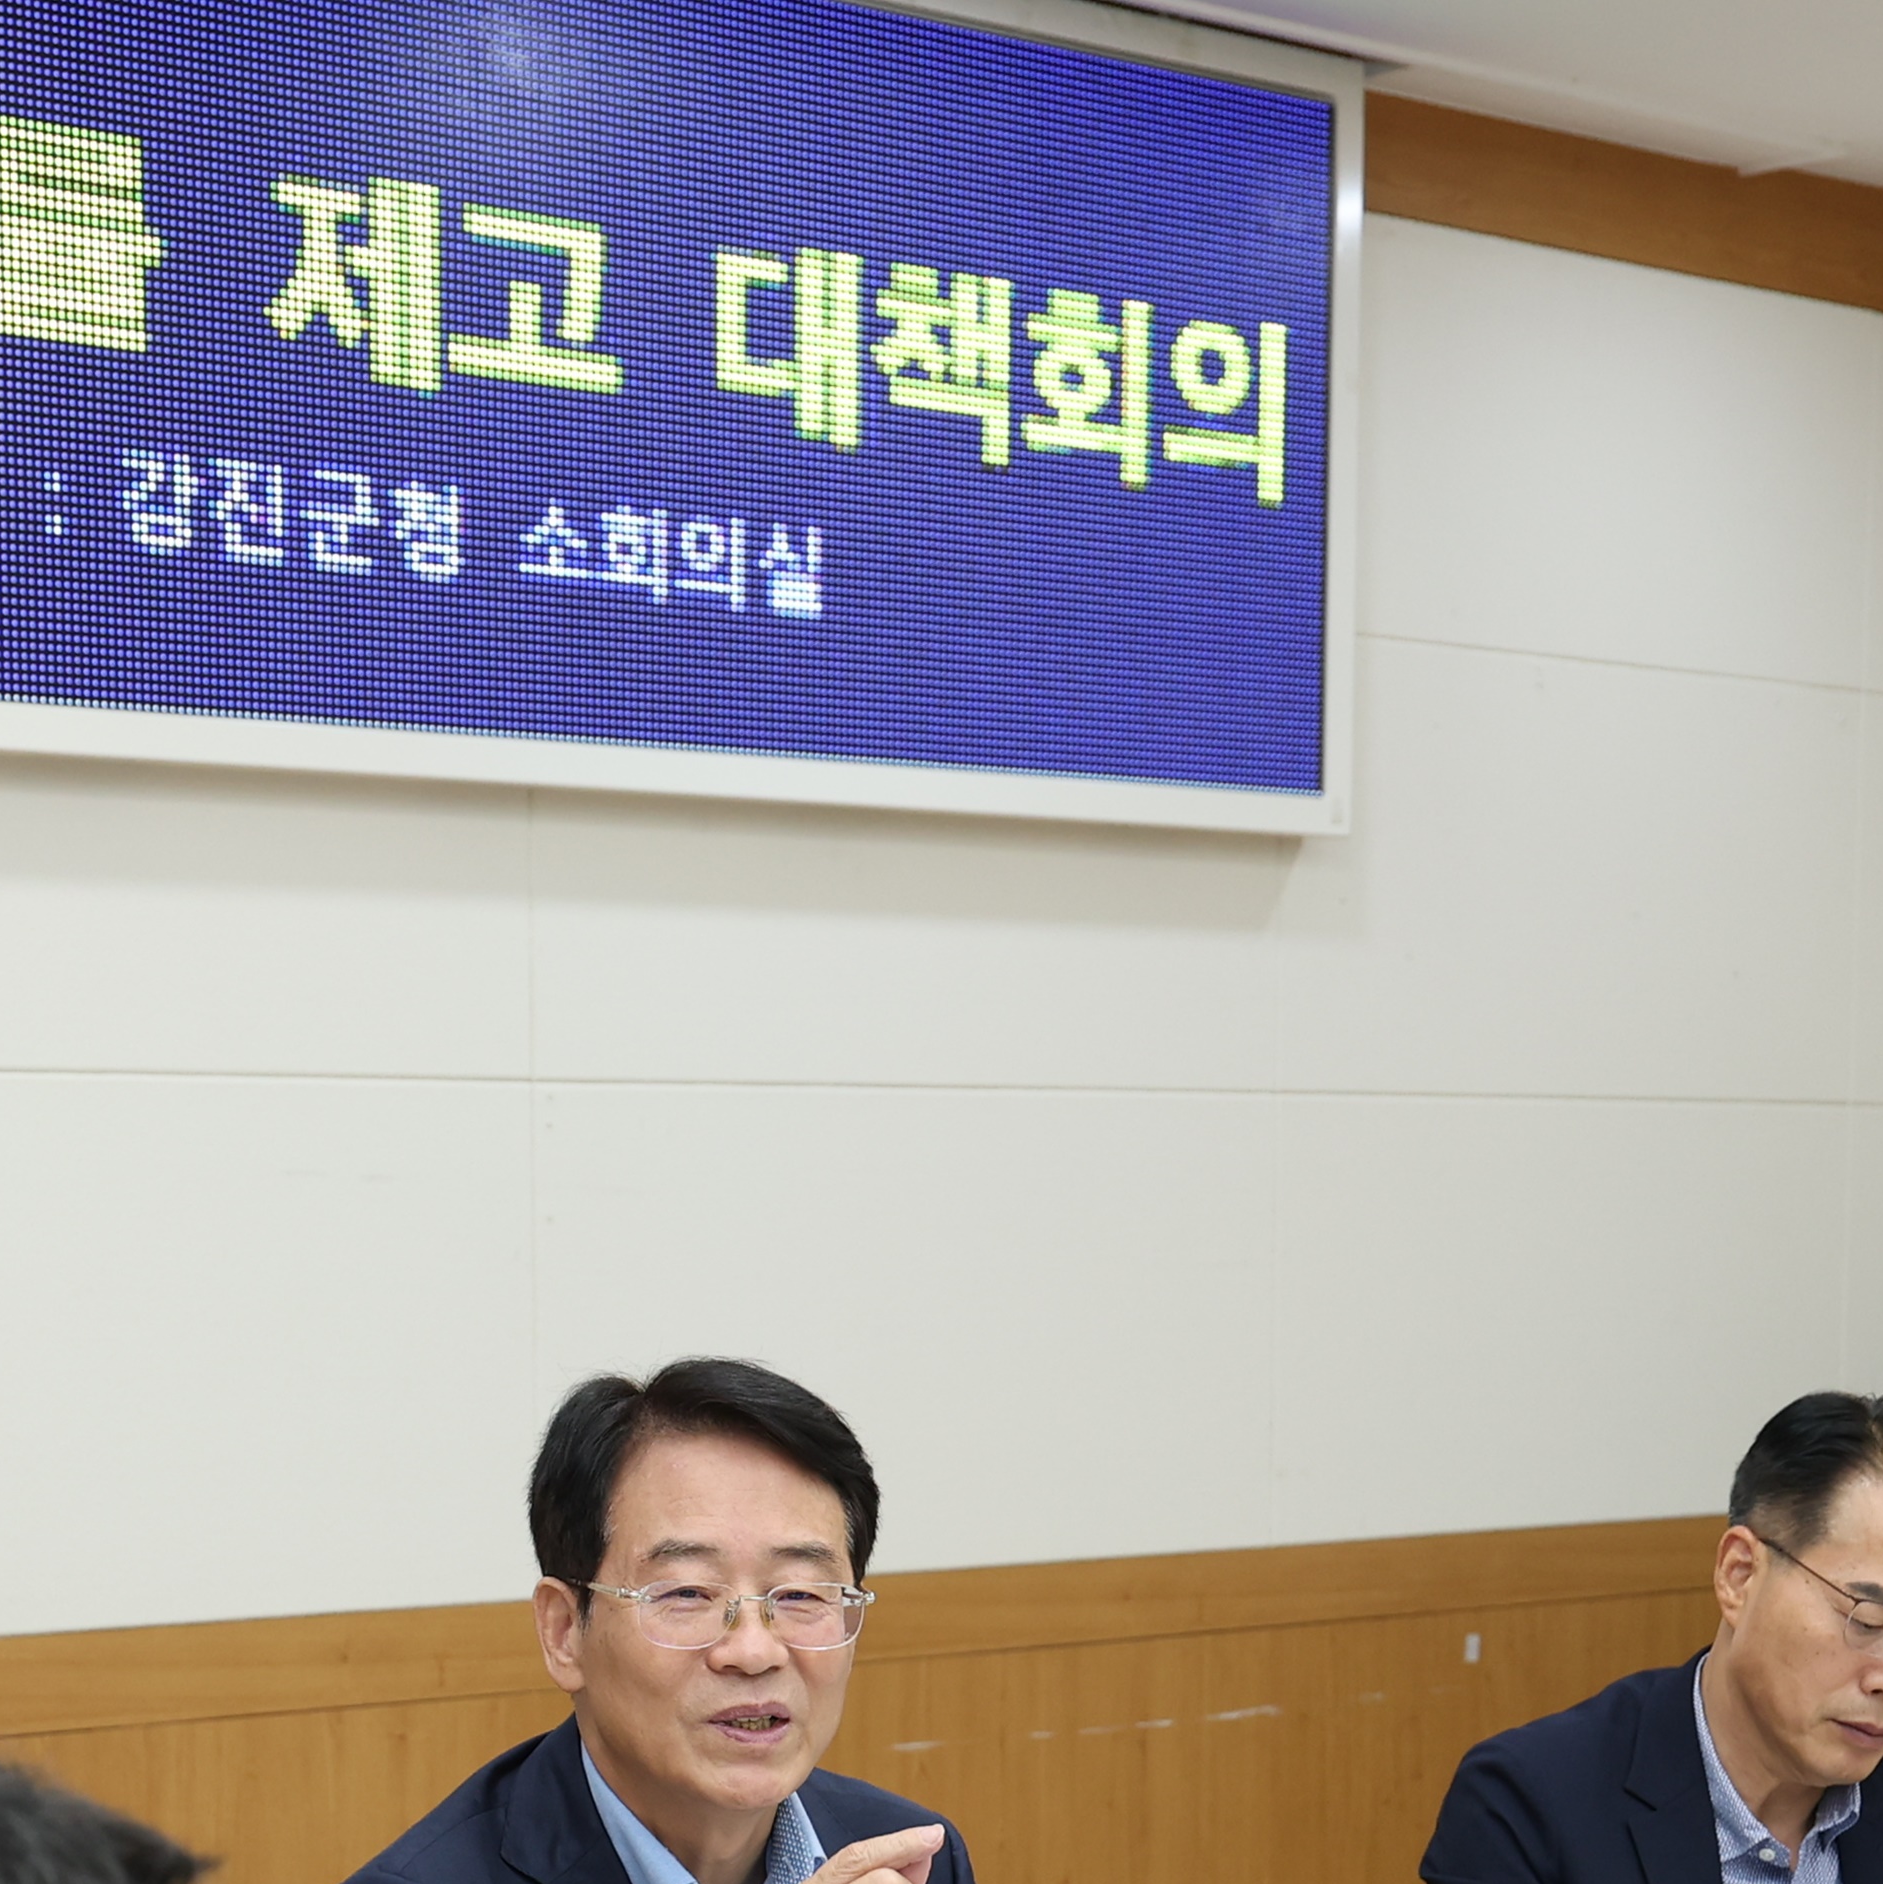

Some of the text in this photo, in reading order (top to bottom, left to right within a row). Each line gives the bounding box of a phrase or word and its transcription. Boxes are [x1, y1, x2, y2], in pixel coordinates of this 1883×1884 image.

[264, 172, 624, 397] 제고
[713, 244, 1288, 508] 대책회의
[120, 446, 466, 584] 강진군청
[516, 496, 822, 622] 소회의실
